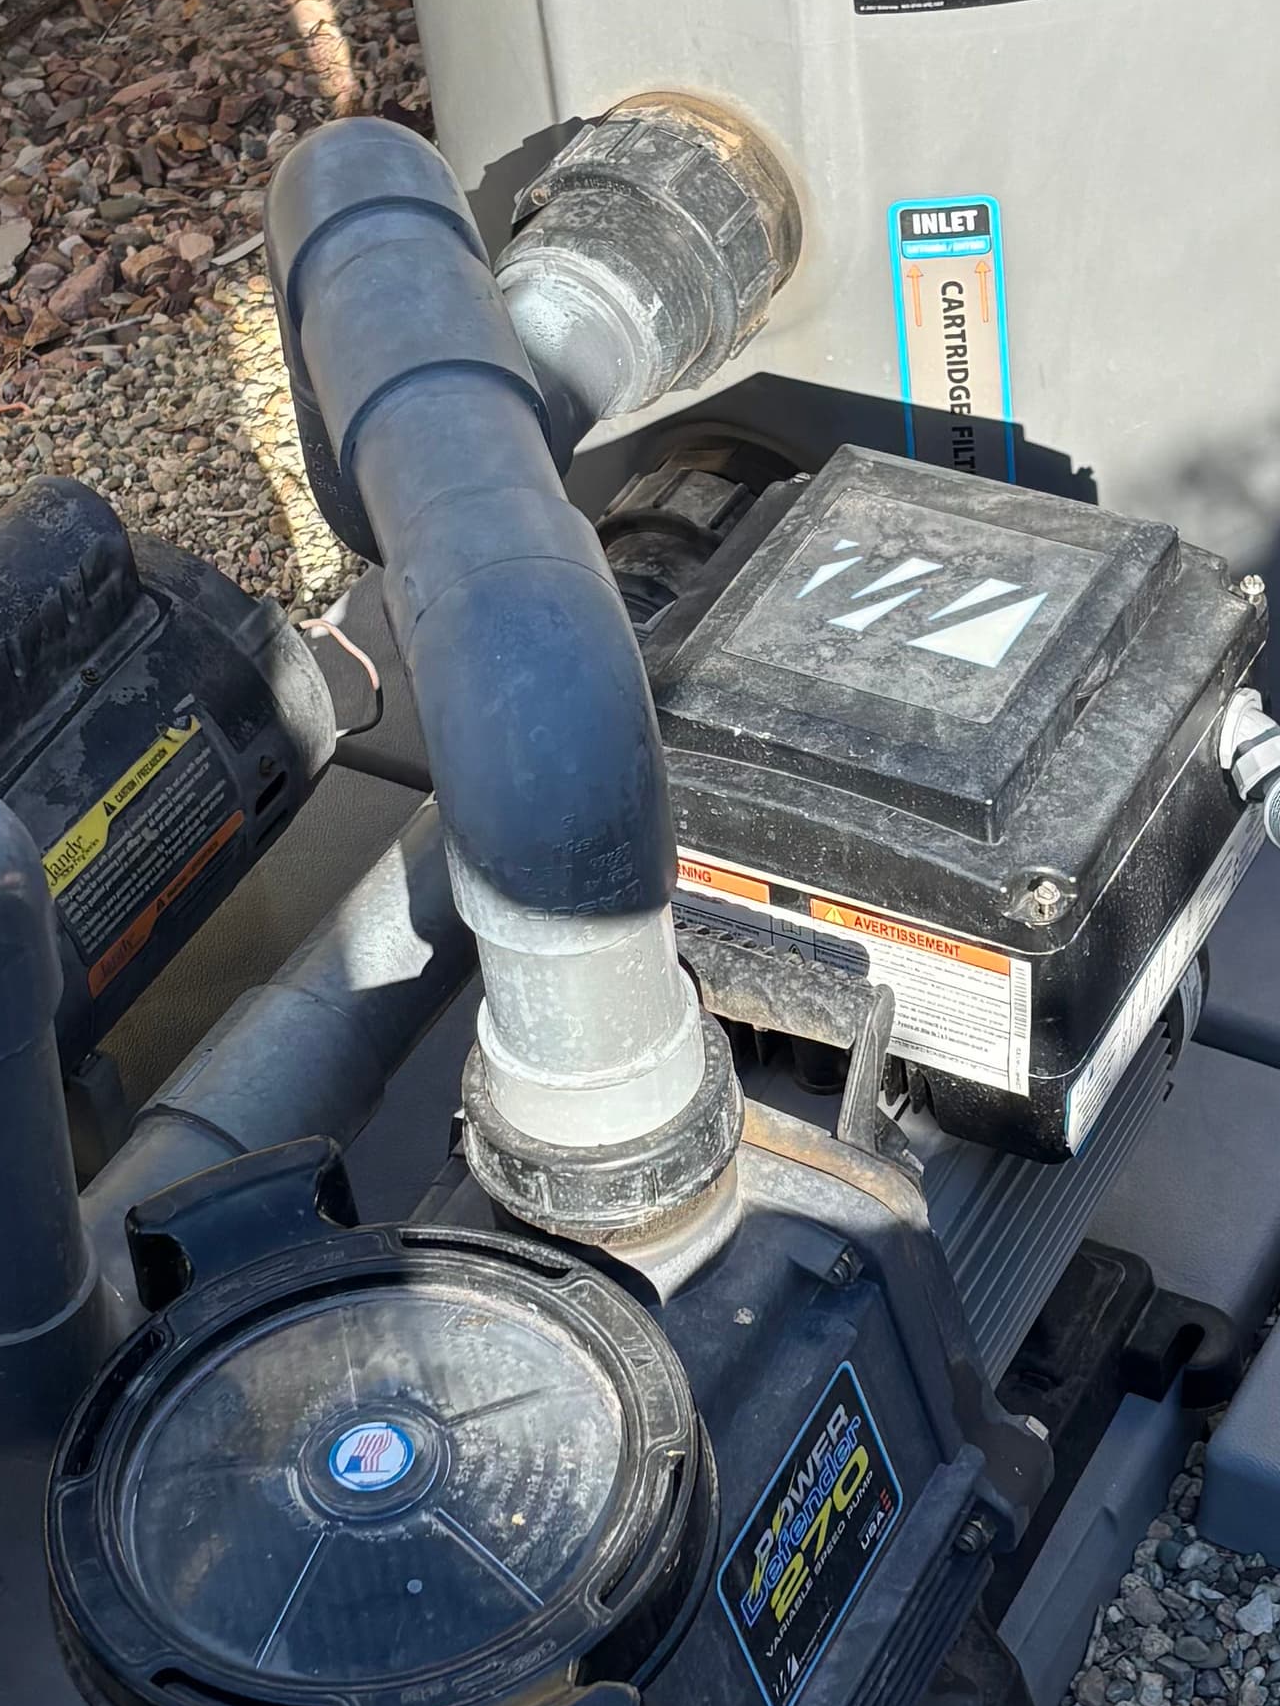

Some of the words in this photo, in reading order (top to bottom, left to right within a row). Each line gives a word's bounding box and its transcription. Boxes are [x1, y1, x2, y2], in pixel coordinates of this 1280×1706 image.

[911, 209, 978, 235] INLET
[940, 280, 972, 415] CARTRIDGE
[952, 426, 976, 474] FILT
[43, 835, 82, 887] Jandy
[677, 863, 712, 883] NING
[854, 916, 961, 959] AVERTISSEMENT
[753, 1403, 849, 1561] POWER
[740, 1415, 862, 1628] Defender
[770, 1444, 870, 1623] 270
[860, 1510, 885, 1551] USA
[765, 1575, 814, 1657] VARIABLE
[814, 1519, 846, 1576] SPEED
[846, 1470, 873, 1520] PUMP
